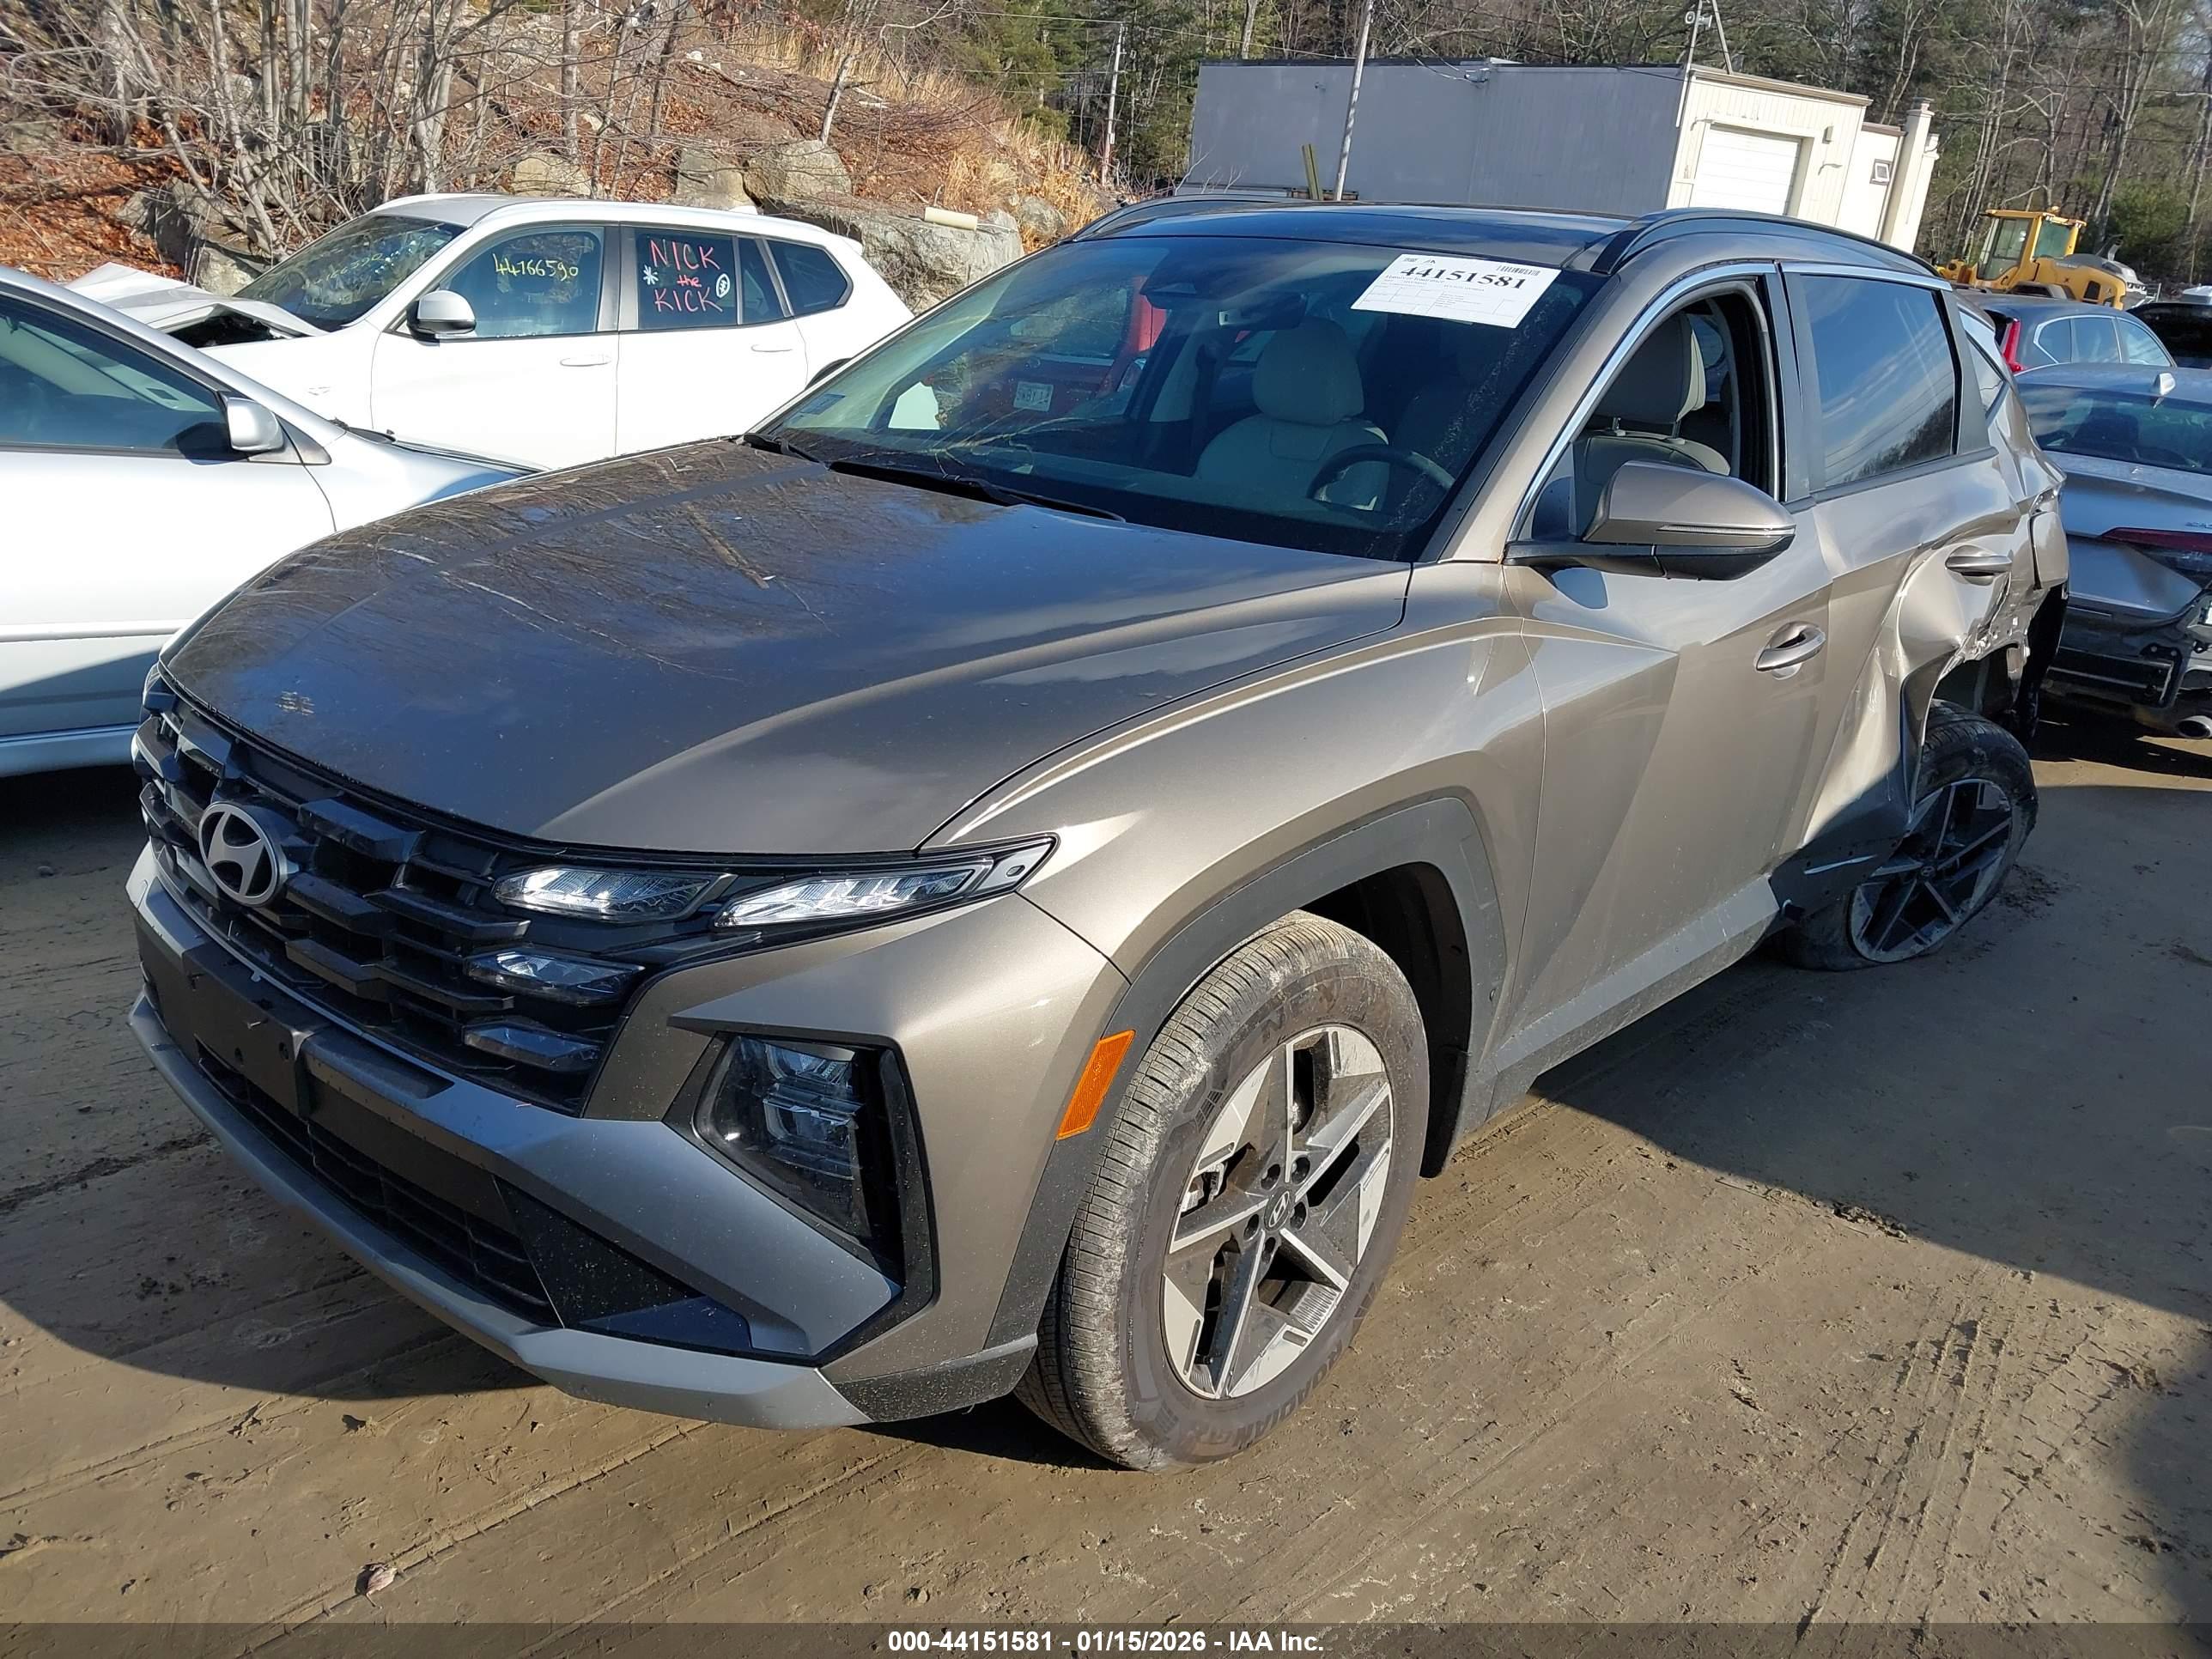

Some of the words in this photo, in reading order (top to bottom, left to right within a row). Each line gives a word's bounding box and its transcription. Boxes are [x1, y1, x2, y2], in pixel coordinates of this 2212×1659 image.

[649, 239, 720, 271] NICK
[676, 274, 702, 288] the
[1401, 266, 1526, 289] 44151581
[653, 286, 724, 313] KICK
